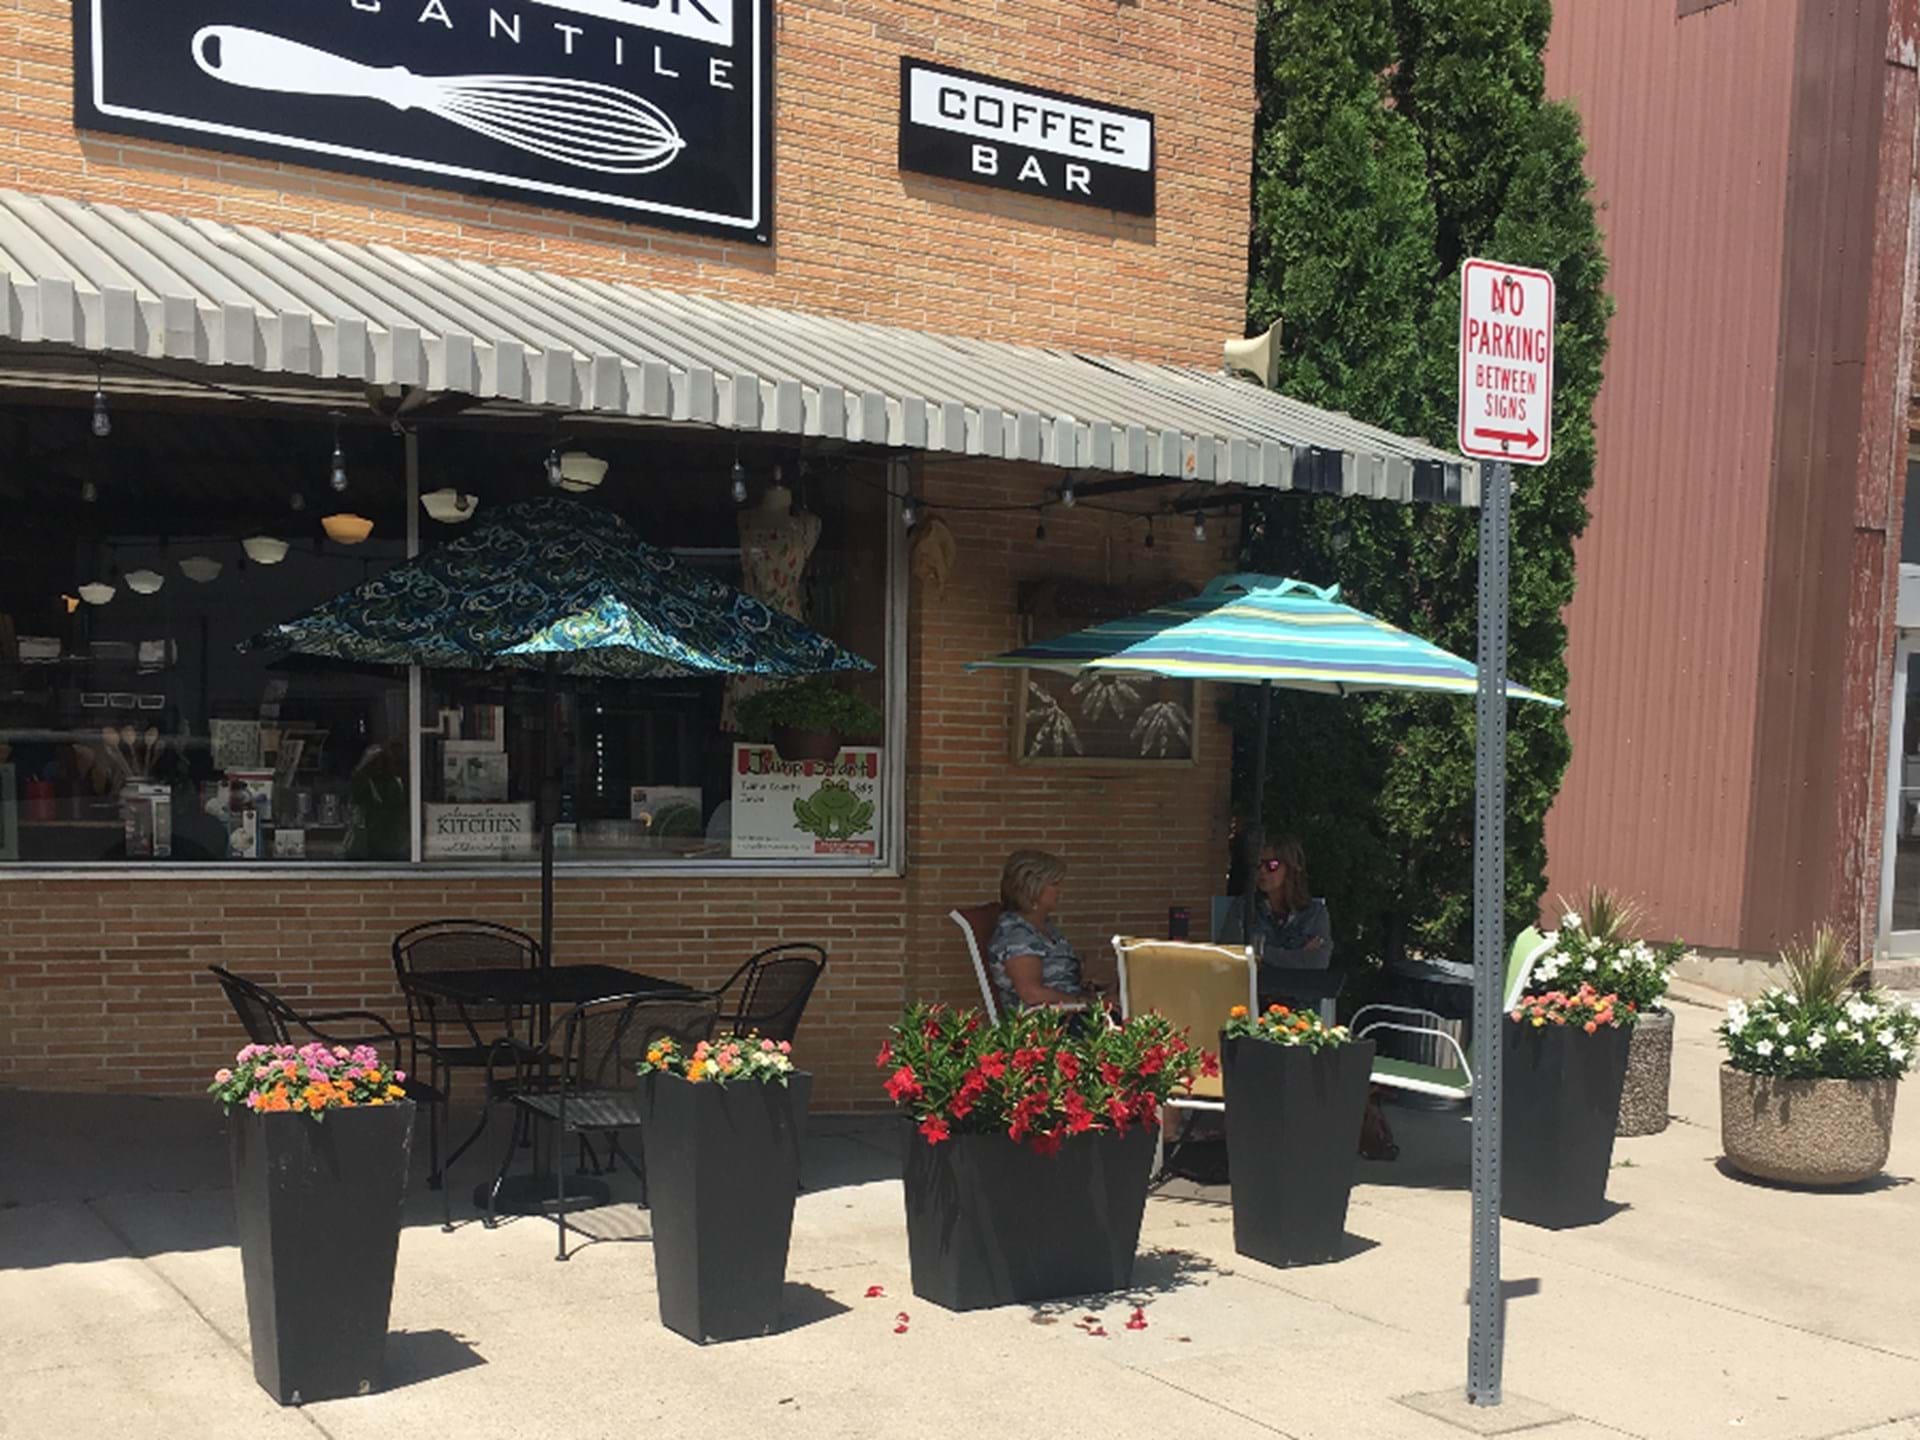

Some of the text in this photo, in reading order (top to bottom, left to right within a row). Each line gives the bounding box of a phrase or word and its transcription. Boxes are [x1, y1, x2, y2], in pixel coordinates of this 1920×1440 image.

[938, 87, 1125, 155] COFFEE
[972, 144, 1092, 196] BAR
[1491, 277, 1524, 317] NO
[1469, 318, 1546, 364] PARKING
[1475, 364, 1537, 395] BETWEEN
[1484, 393, 1527, 422] SIGNS
[436, 817, 521, 834] KITCHEN
